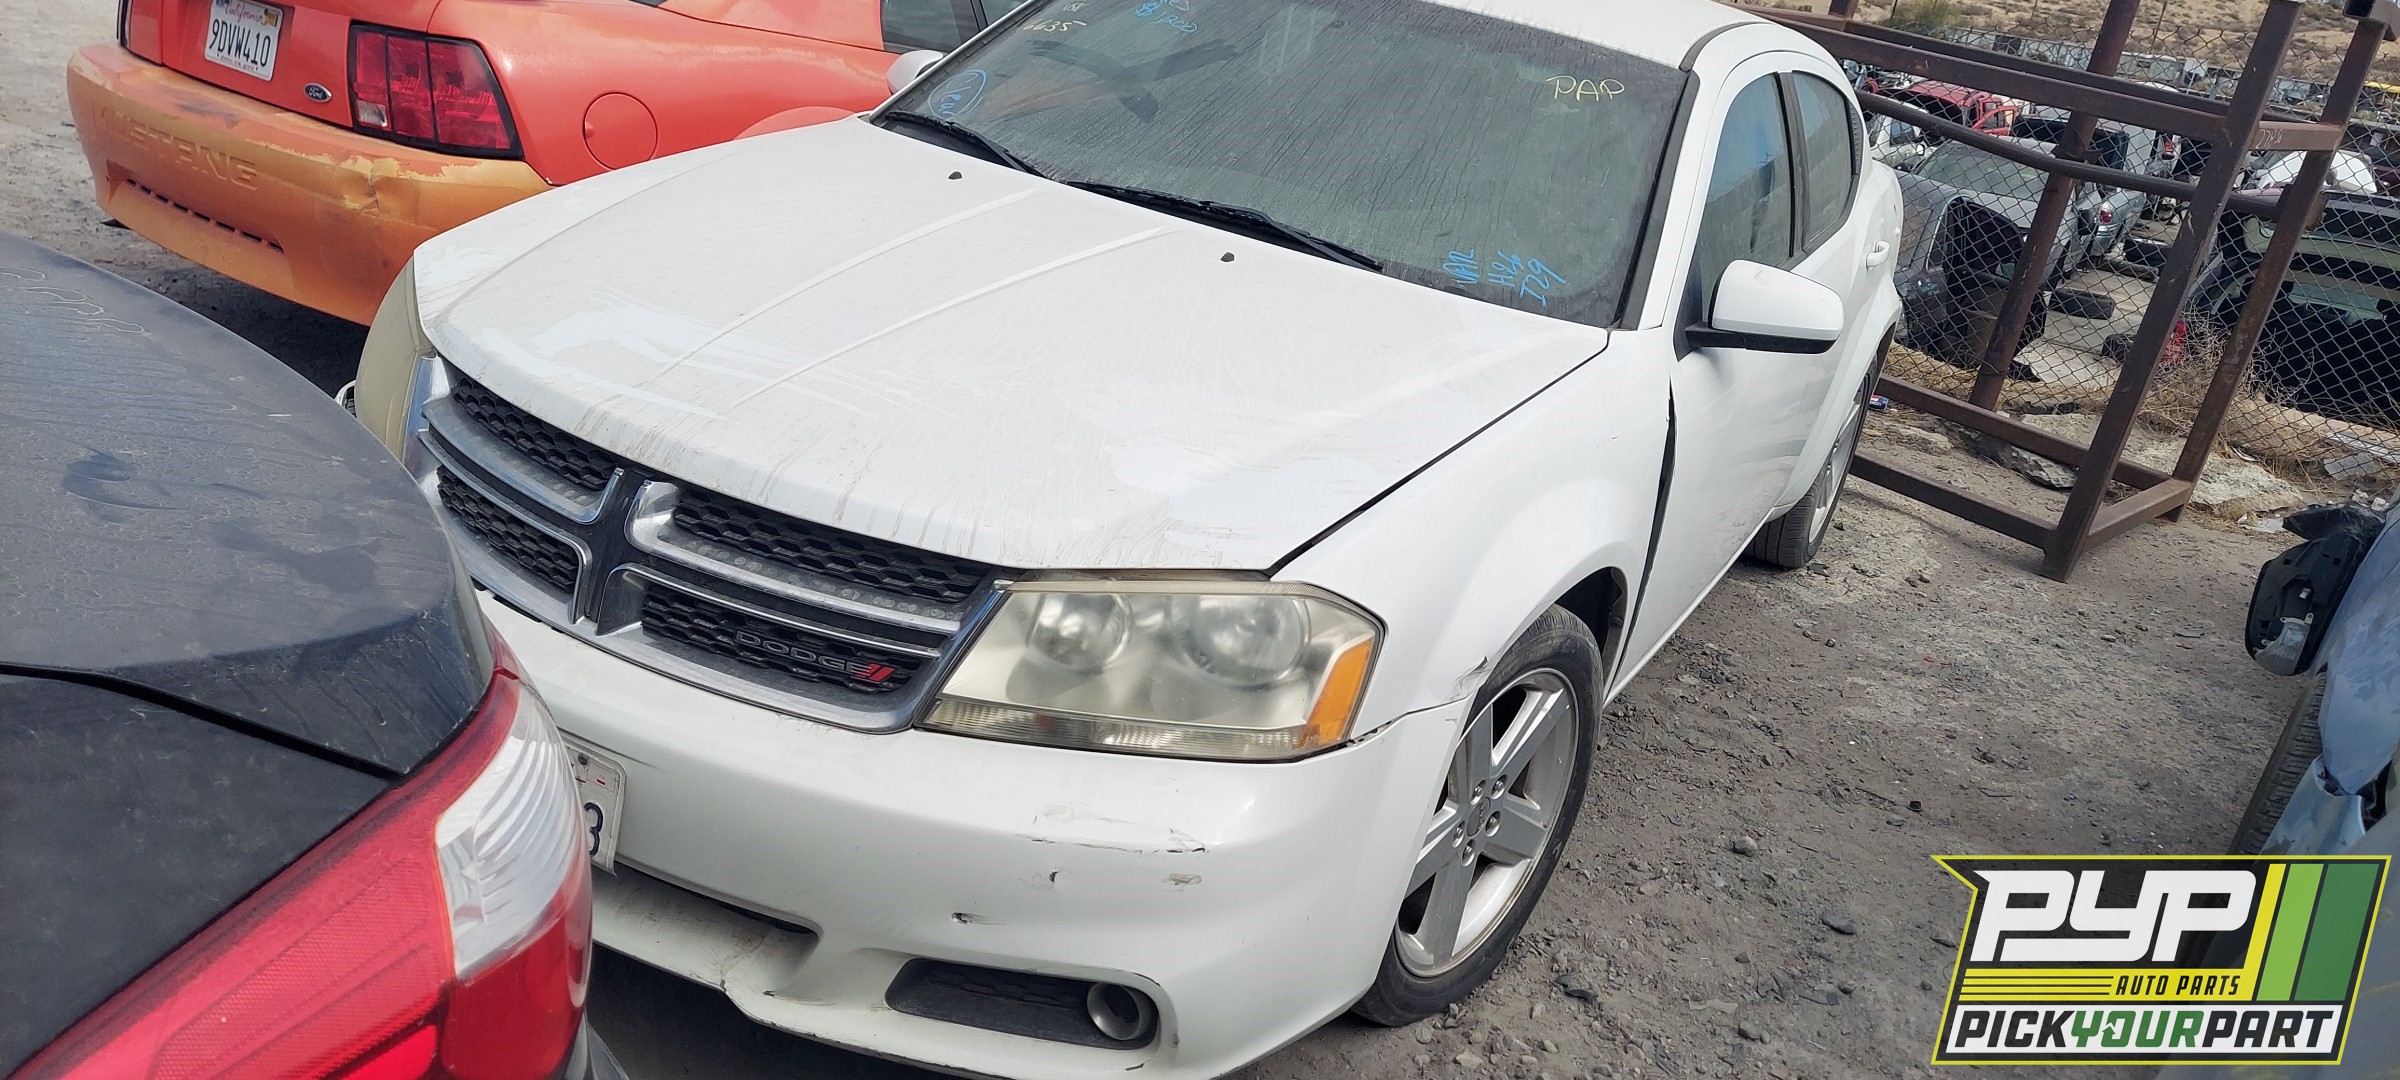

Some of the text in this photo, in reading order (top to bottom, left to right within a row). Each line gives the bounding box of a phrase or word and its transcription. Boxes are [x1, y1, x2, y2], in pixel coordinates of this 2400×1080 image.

[224, 1, 264, 23] California
[208, 18, 272, 68] 9DVW410
[735, 630, 871, 675] DODGE
